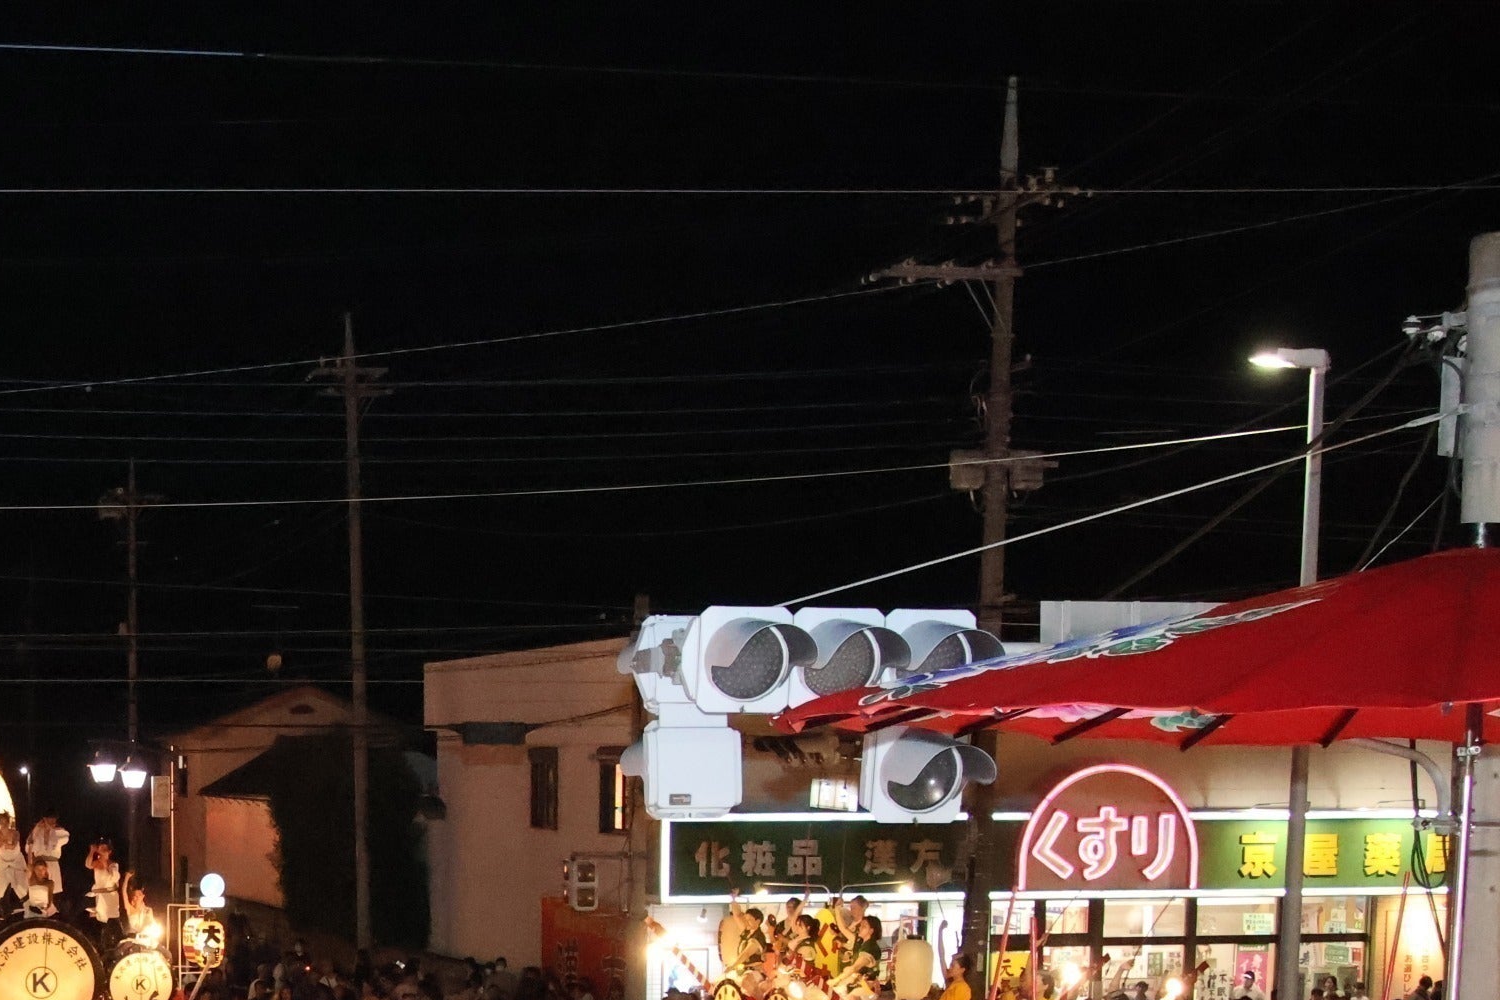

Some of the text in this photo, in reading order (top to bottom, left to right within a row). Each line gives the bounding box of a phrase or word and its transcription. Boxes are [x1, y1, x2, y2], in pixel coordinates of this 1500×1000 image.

[695, 839, 823, 877] 化粧品
[1031, 806, 1176, 882] くすり
[32, 972, 50, 993] K
[136, 979, 146, 990] K
